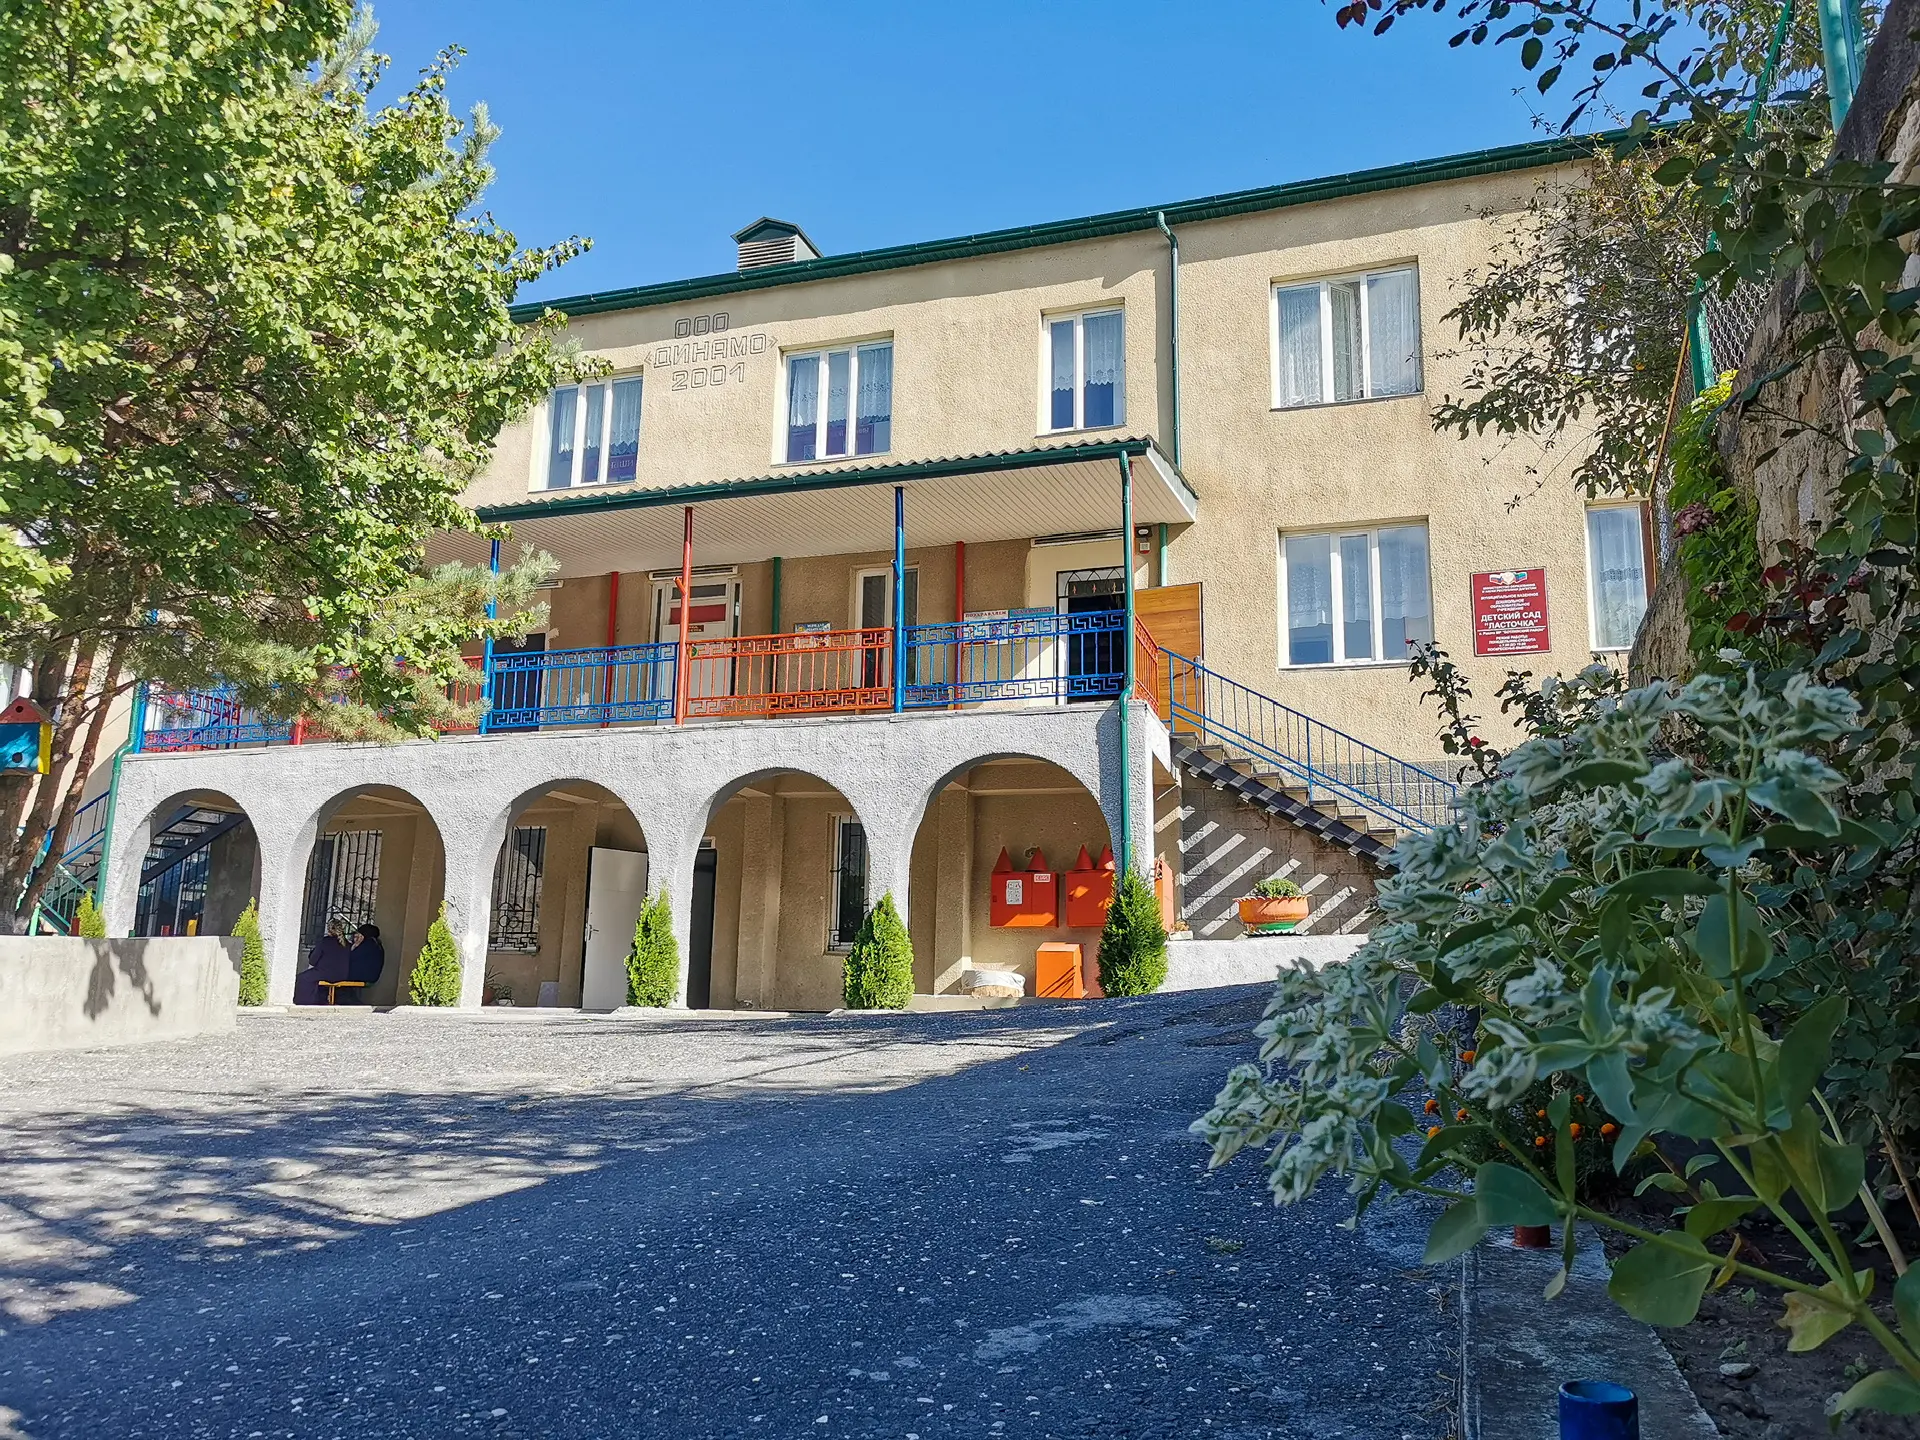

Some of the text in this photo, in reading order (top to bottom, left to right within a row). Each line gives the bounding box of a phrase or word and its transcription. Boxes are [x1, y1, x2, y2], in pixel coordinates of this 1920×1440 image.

[674, 312, 730, 339] ООО
[671, 362, 745, 391] 2001
[1480, 611, 1542, 622] ДЕТСКИЙ САД
[1484, 620, 1538, 629] "ЛАСТОЧКА"
